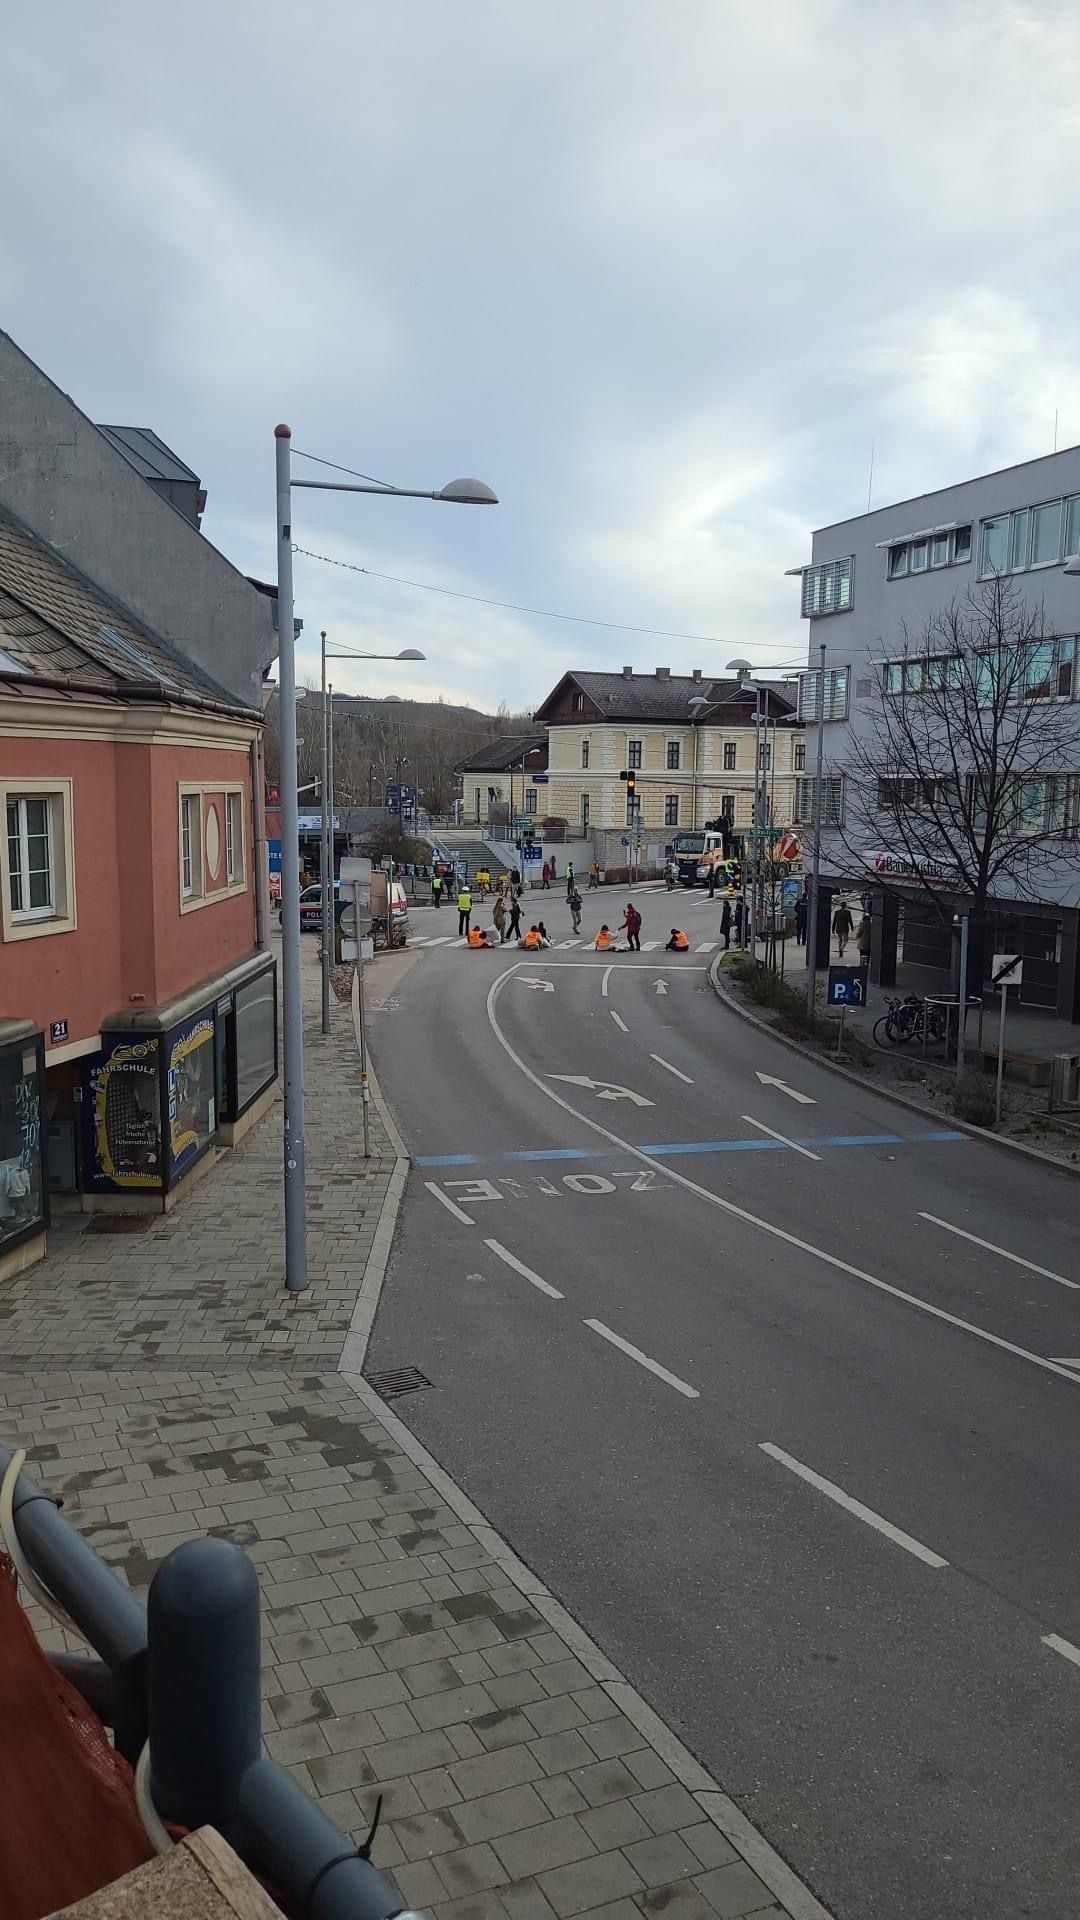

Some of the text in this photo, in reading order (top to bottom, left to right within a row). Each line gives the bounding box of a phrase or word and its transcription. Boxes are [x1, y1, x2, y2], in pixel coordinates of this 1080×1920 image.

[834, 983, 846, 998] P
[54, 1022, 66, 1035] 21
[91, 1064, 156, 1077] FAHRSCHULE
[443, 1170, 675, 1202] ZONE
